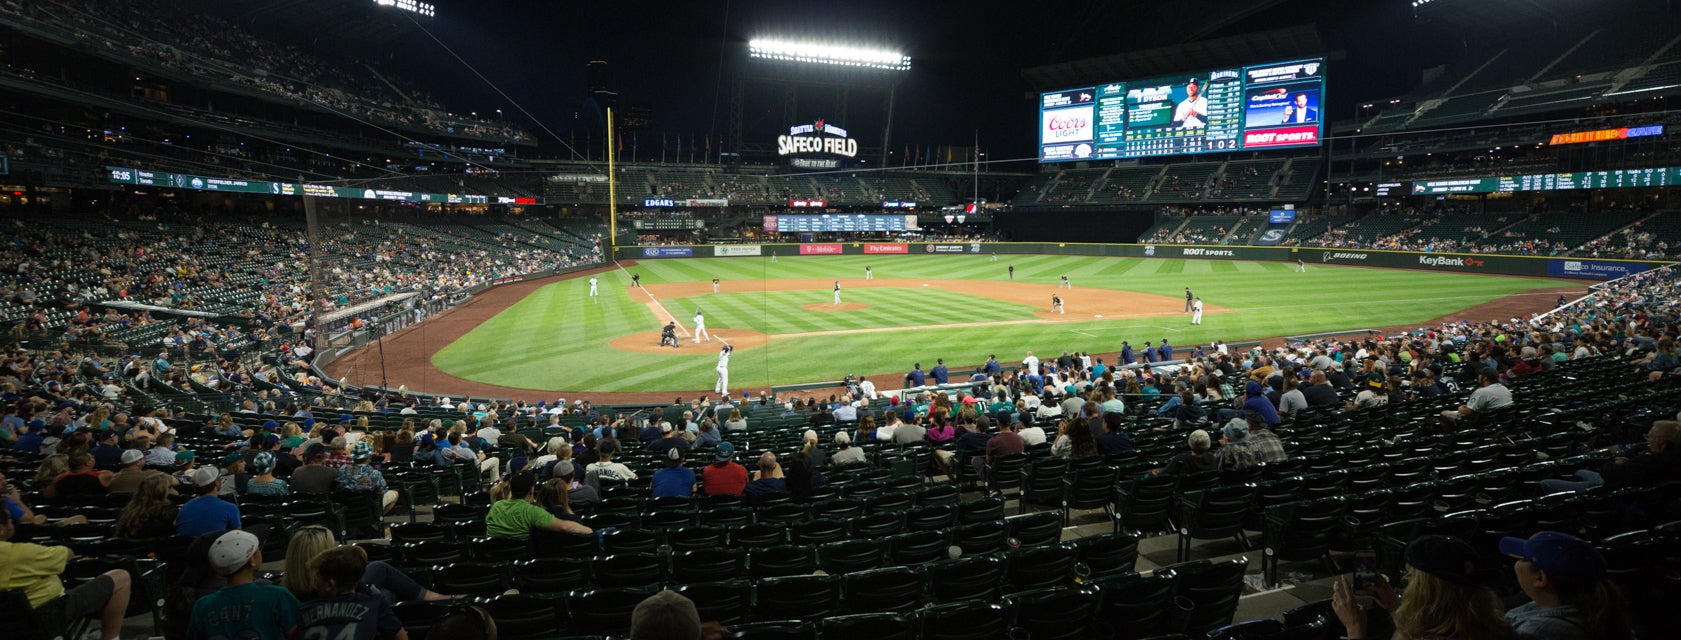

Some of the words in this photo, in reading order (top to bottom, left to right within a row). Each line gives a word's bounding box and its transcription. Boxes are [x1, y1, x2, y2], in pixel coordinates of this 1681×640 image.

[1047, 115, 1086, 131] Coors
[1055, 128, 1079, 138] LIGHT
[1246, 133, 1277, 144] ROOT
[778, 134, 822, 155] SAFECO
[824, 138, 857, 157] FIELD
[1208, 141, 1213, 150] 1
[1218, 140, 1225, 149] 0
[1229, 139, 1236, 149] 2
[1419, 255, 1464, 266] KeyBank
[1566, 261, 1589, 271] Safeco
[303, 602, 370, 625] HERNANDEZ
